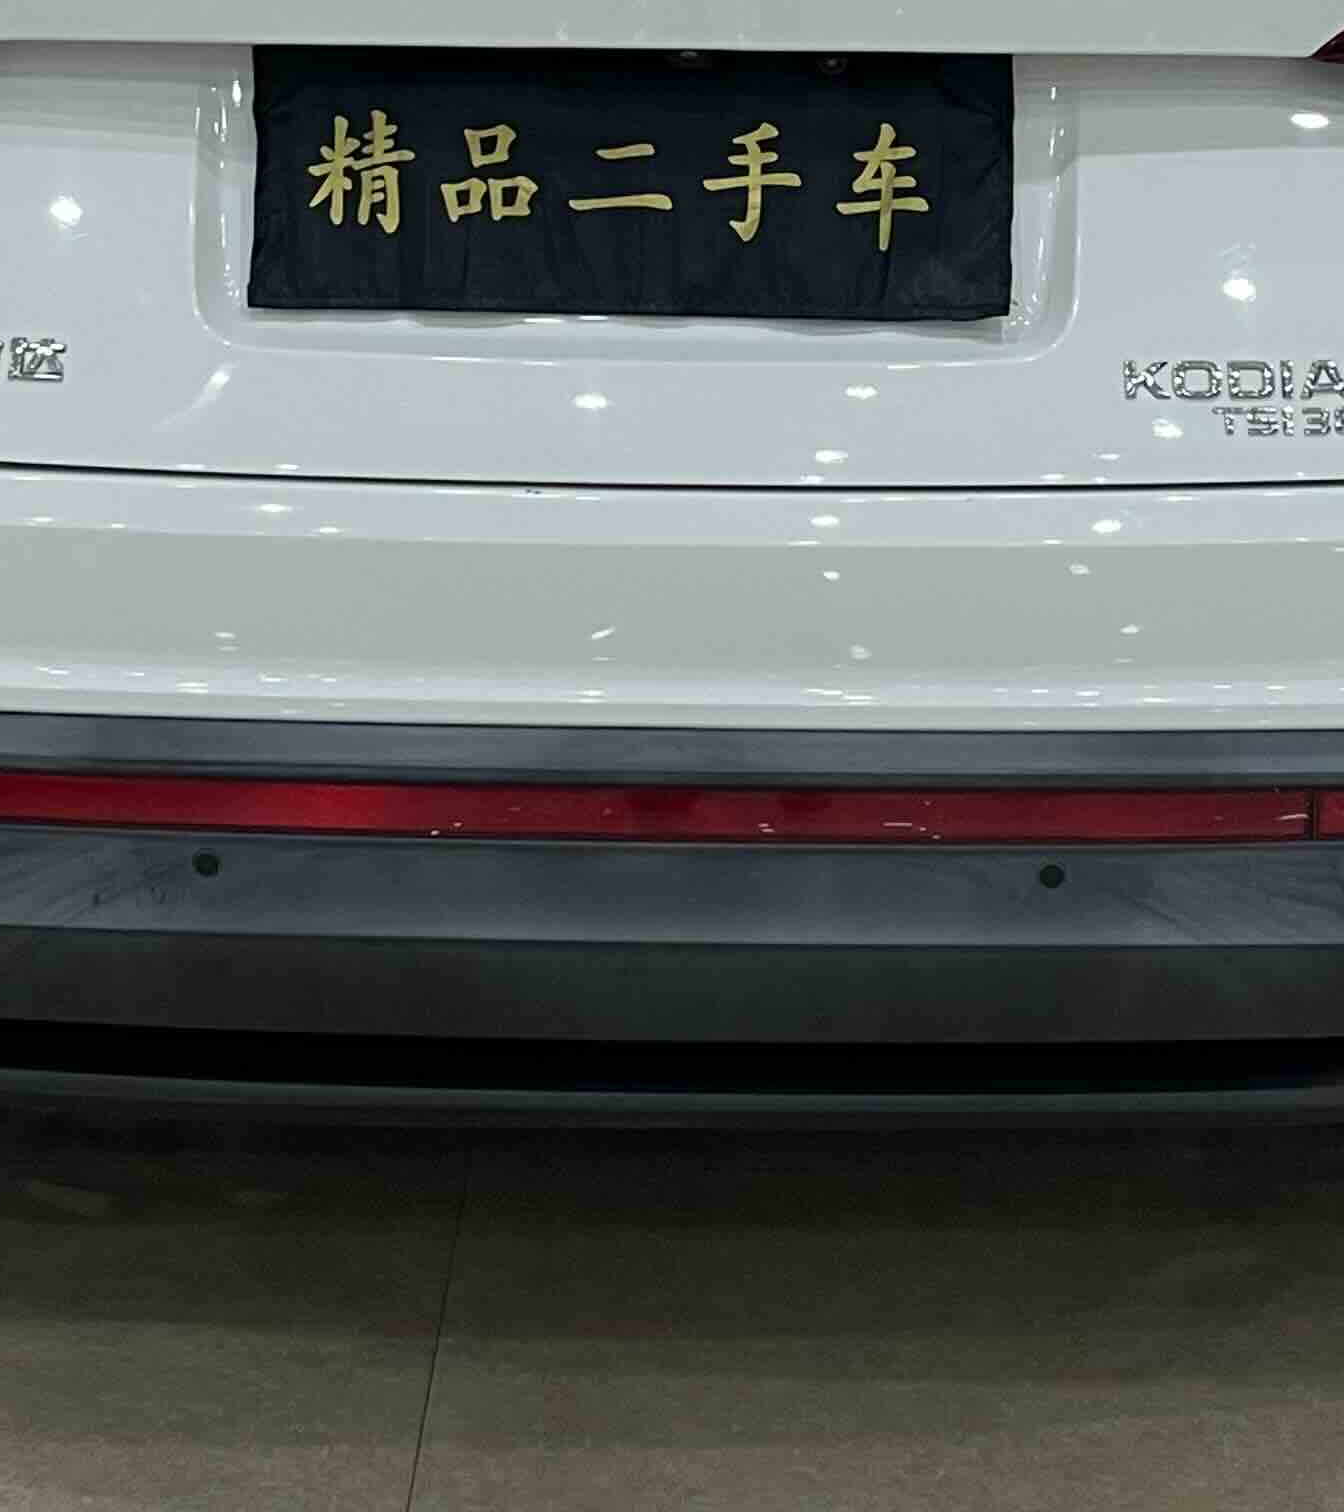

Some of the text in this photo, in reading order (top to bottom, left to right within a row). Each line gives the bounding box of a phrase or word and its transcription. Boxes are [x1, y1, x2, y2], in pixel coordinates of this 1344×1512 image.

[308, 109, 932, 252] 精品二手车
[1213, 404, 1294, 436] TSI
